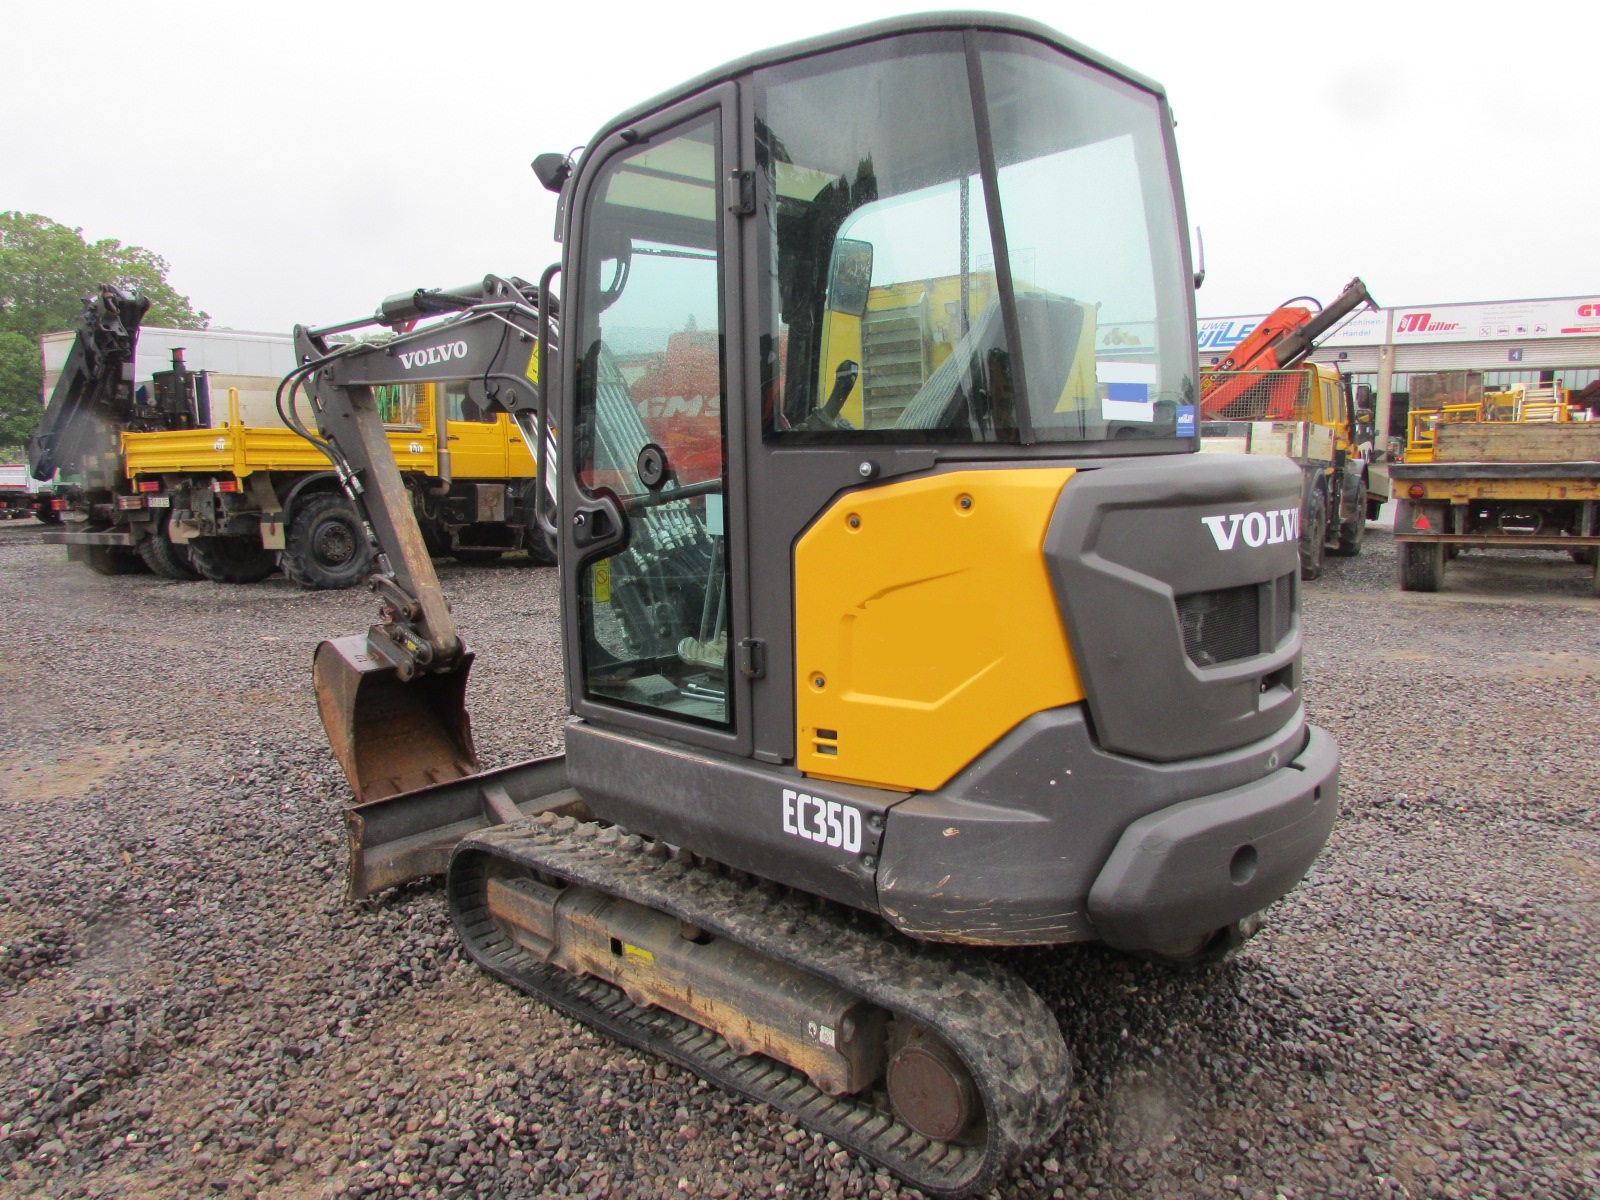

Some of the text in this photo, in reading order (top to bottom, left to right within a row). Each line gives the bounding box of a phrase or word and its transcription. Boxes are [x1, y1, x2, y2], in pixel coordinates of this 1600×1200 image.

[1201, 321, 1228, 330] UWE
[1396, 312, 1460, 333] Müller
[399, 340, 468, 370] VOLVO
[1511, 350, 1519, 361] 4
[782, 788, 862, 853] EC35D
